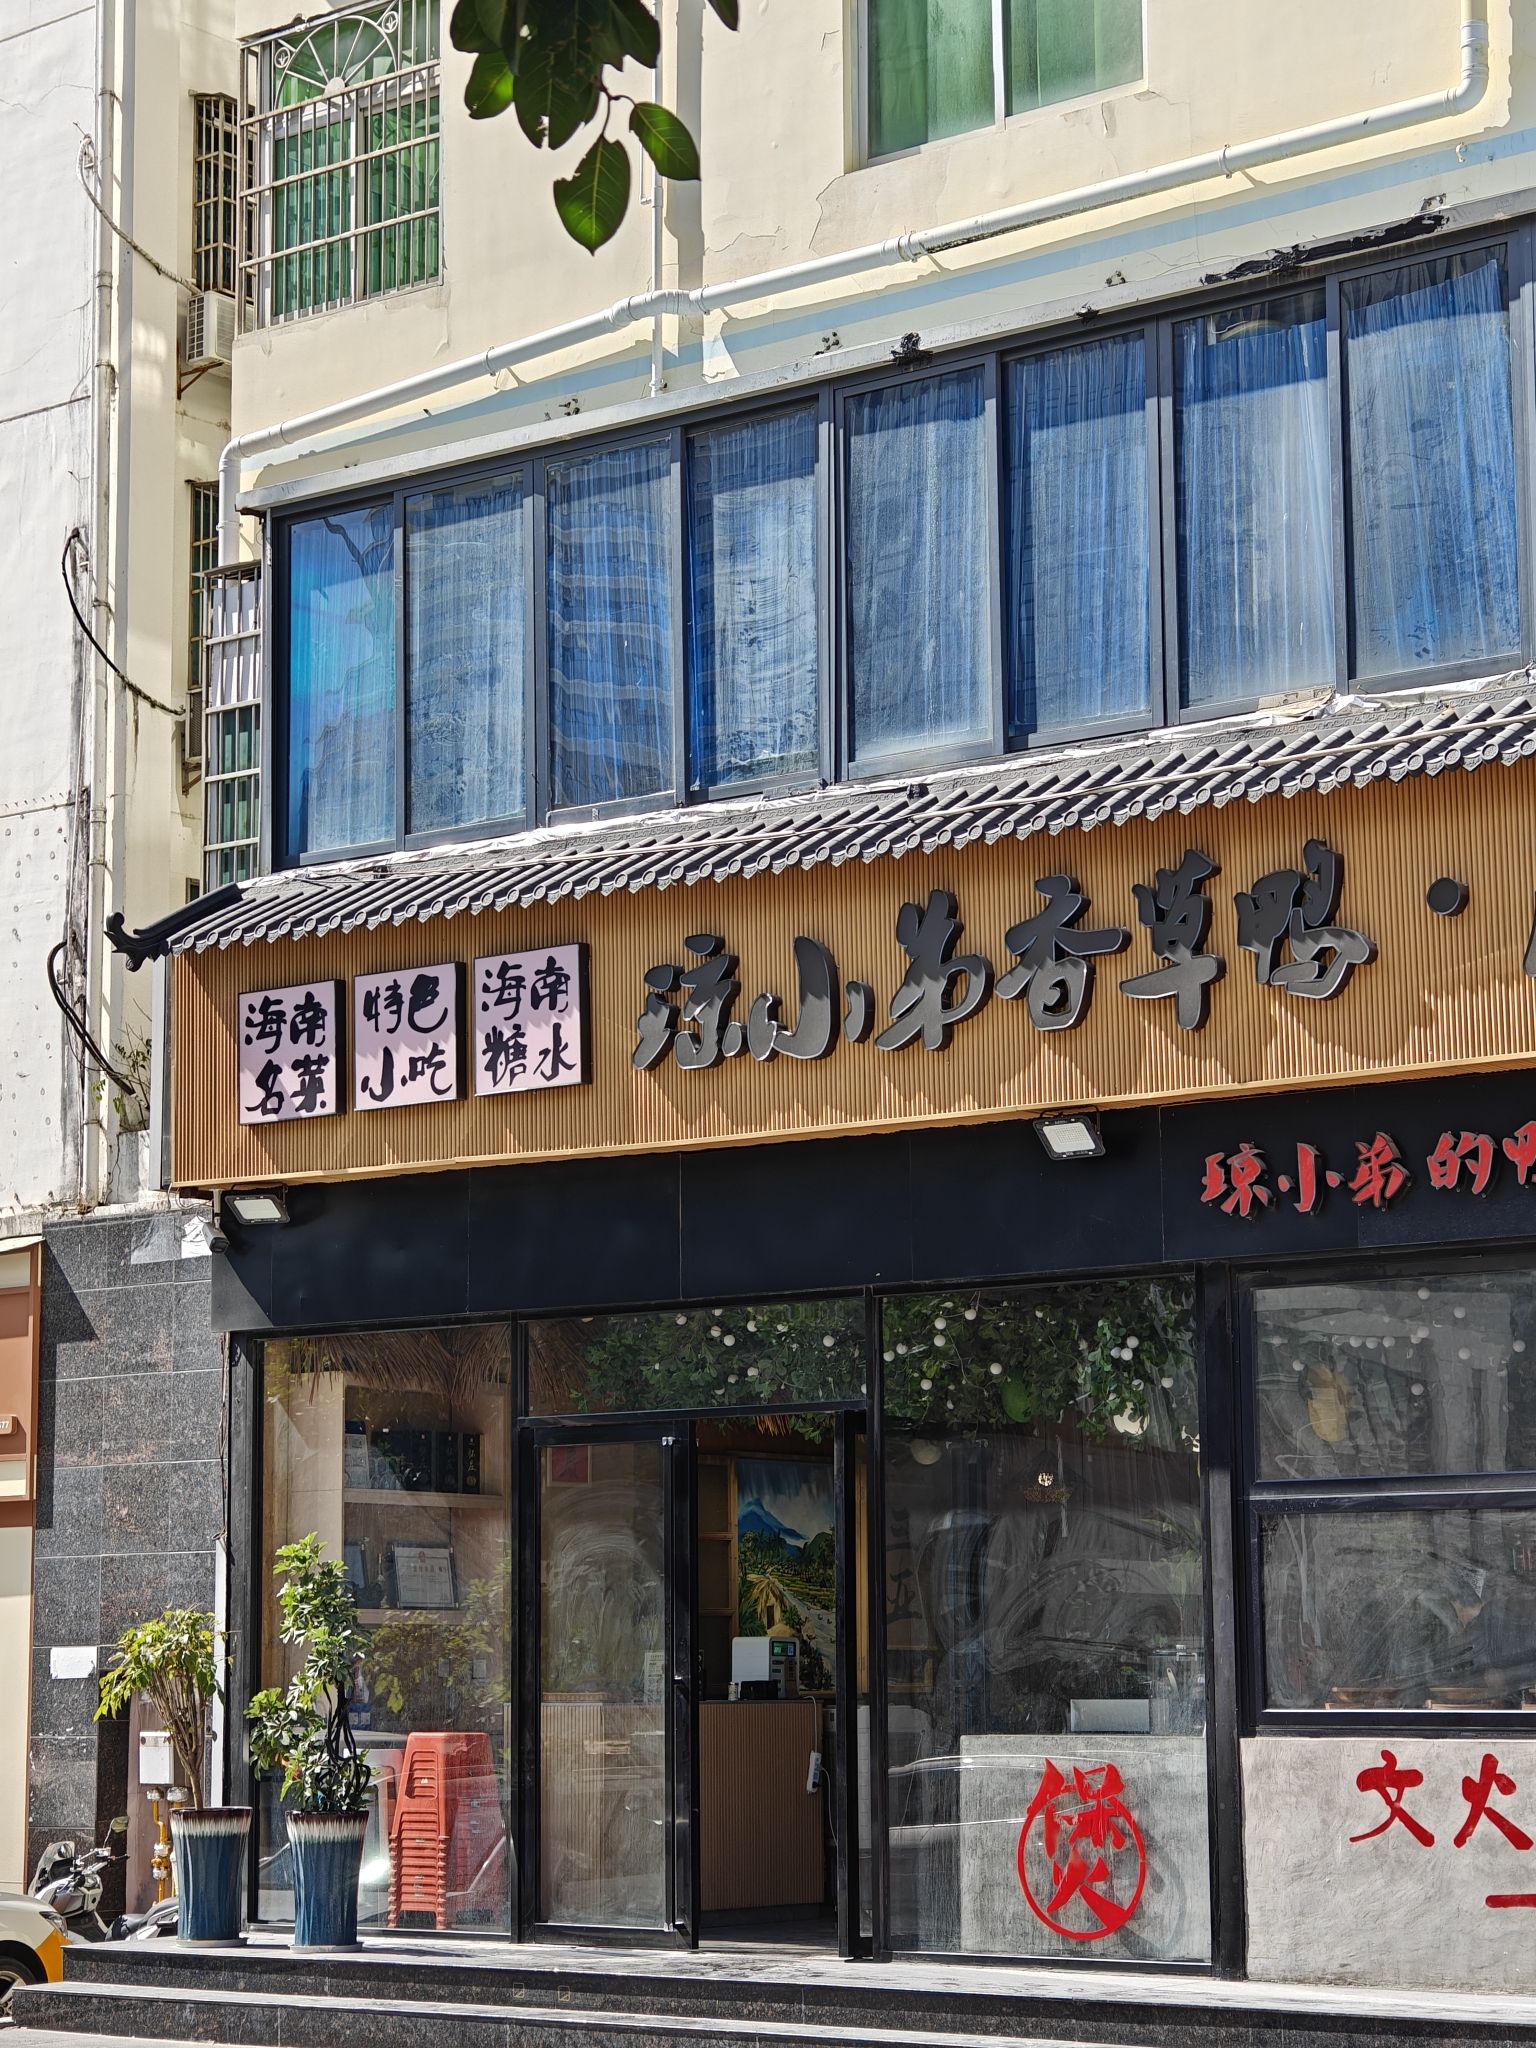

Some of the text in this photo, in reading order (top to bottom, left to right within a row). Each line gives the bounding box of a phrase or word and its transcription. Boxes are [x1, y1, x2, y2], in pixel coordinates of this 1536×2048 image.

[363, 974, 449, 1034] 特色
[481, 956, 572, 1020] 海南
[244, 991, 328, 1054] 海南
[244, 1053, 330, 1116] 名菜
[361, 1042, 453, 1101] 小吃
[482, 1022, 577, 1088] 糖水
[1349, 1750, 1535, 1851] 文火
